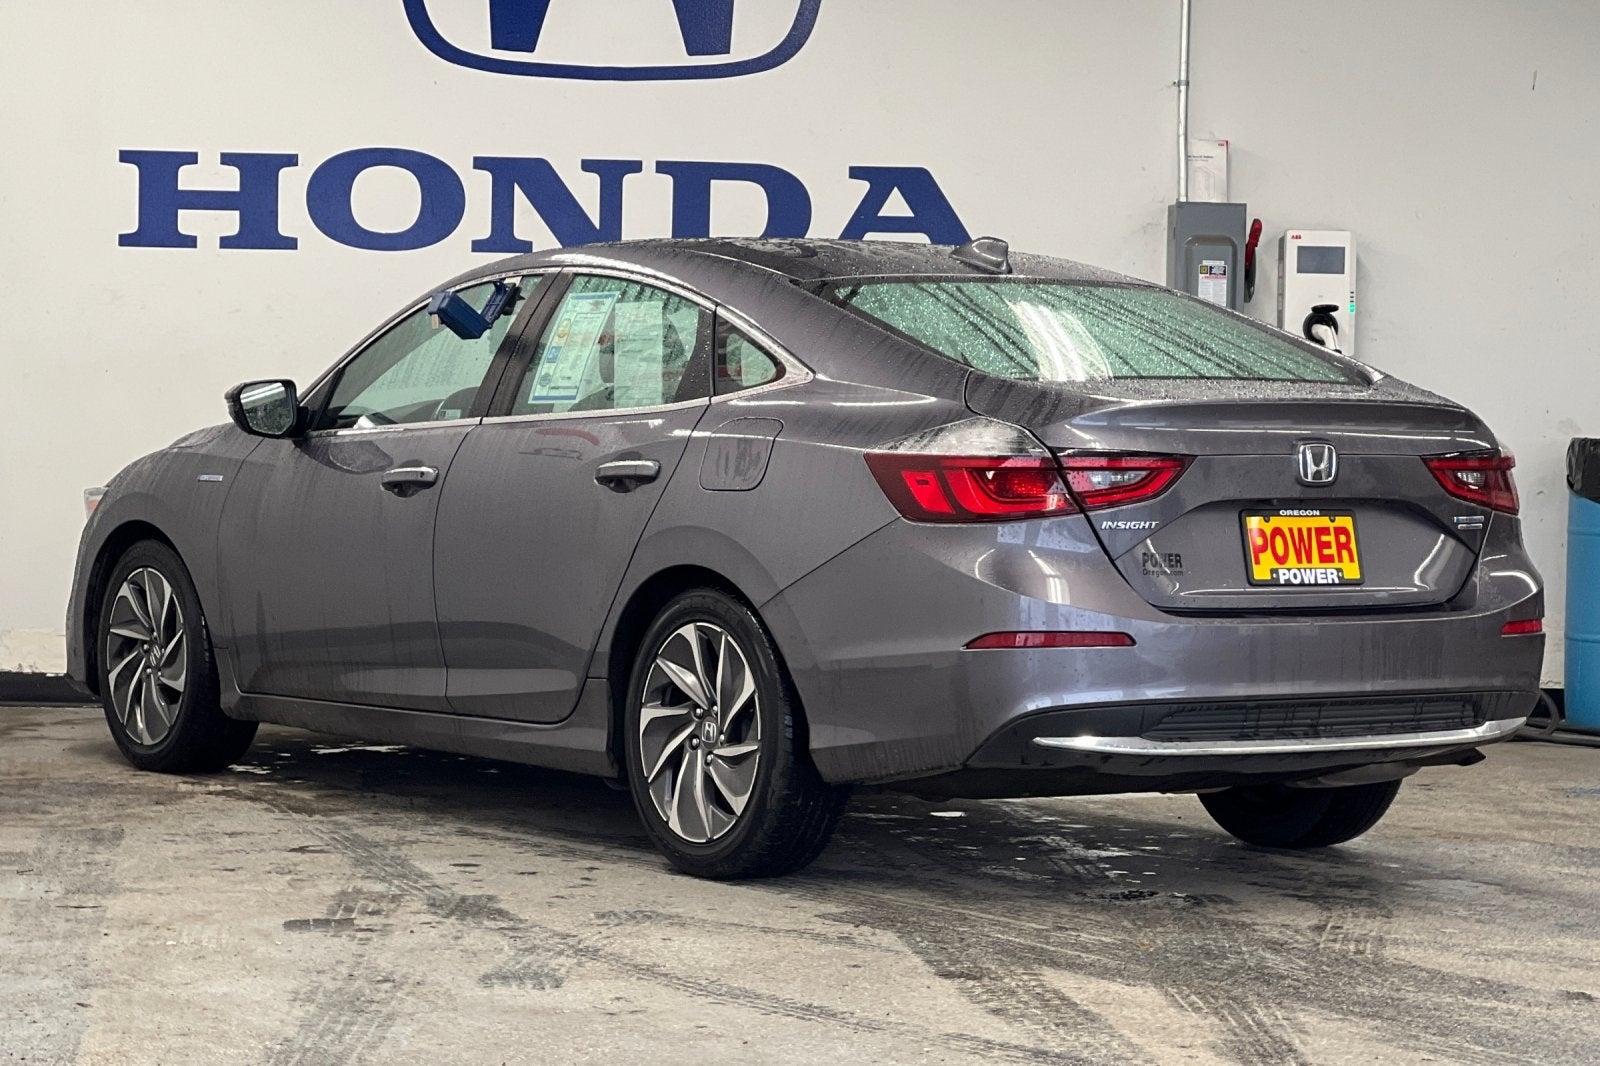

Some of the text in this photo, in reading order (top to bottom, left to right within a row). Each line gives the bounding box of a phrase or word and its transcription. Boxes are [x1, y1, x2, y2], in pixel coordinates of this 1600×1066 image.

[118, 148, 969, 253] HONDA
[1101, 521, 1159, 530] INSIGHT
[1248, 526, 1355, 566] POWER
[1278, 568, 1339, 584] POWER
